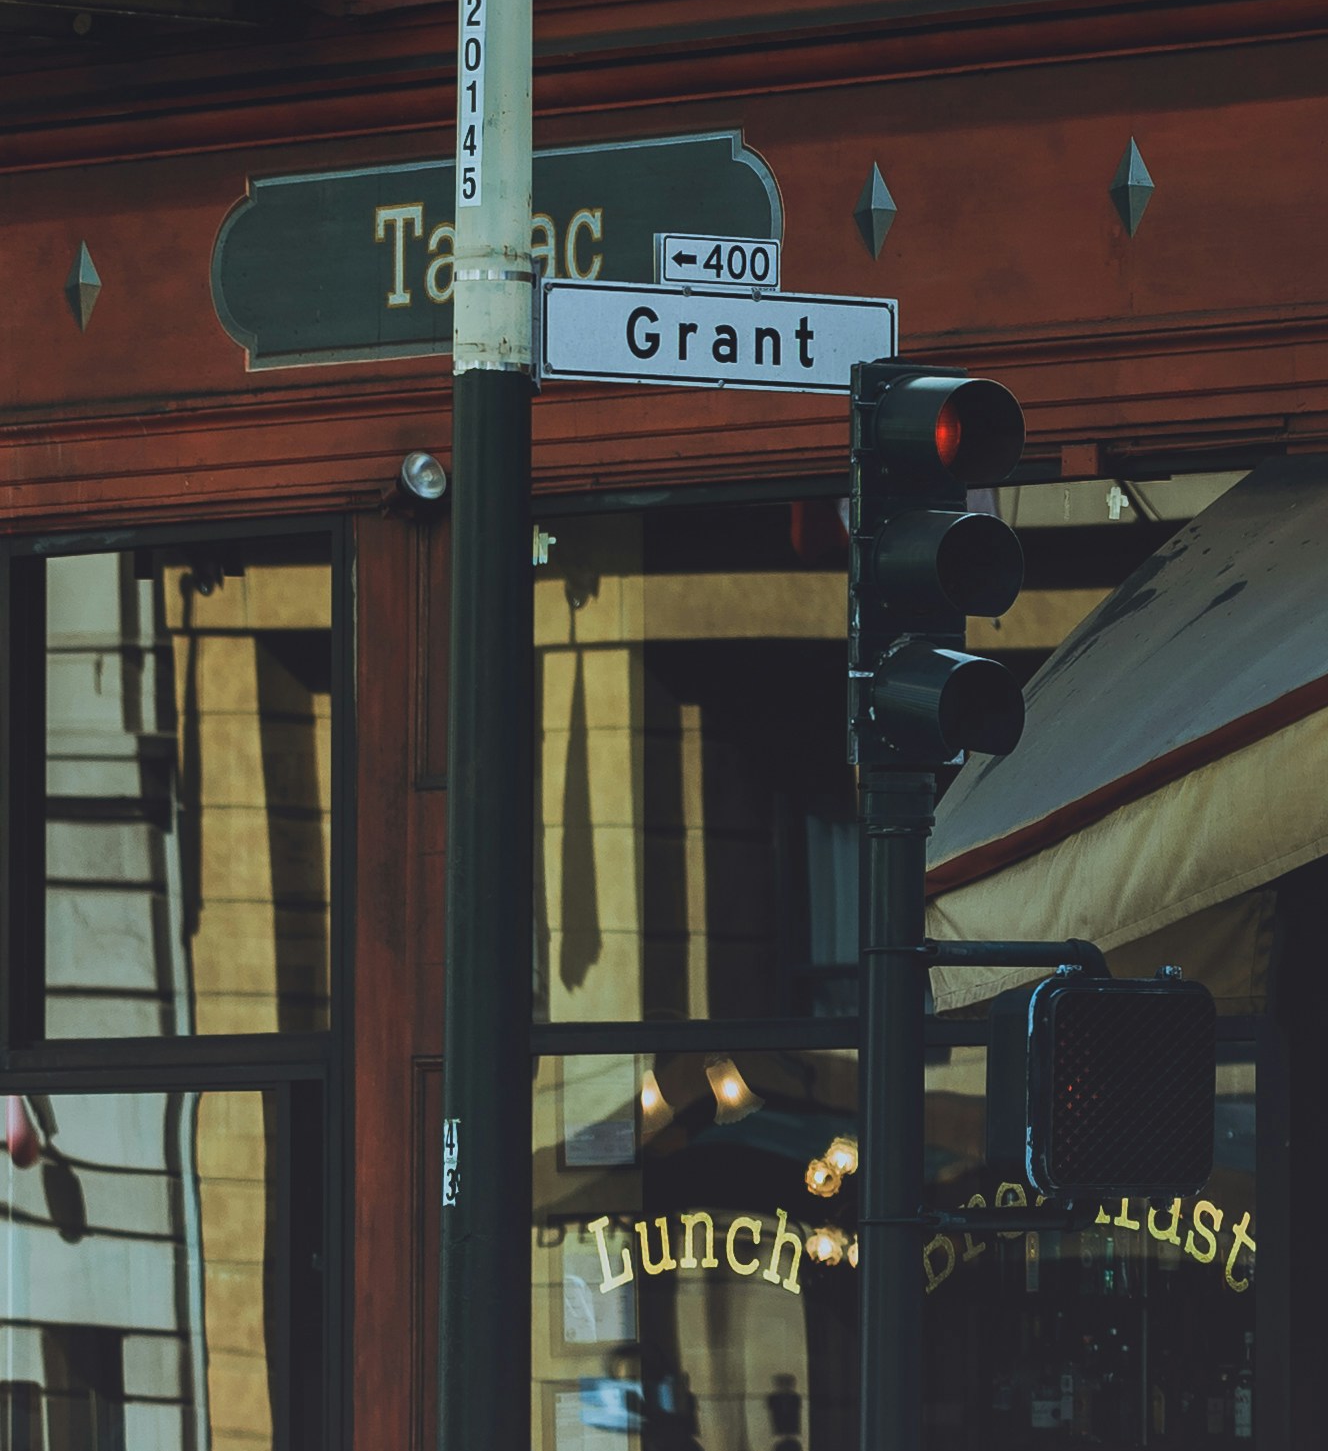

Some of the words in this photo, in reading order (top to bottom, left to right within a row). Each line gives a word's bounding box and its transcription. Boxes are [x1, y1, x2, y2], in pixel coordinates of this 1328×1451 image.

[373, 201, 604, 309] Taac
[702, 243, 772, 282] 400
[625, 305, 815, 369] Grant
[587, 1206, 802, 1295] Lunch
